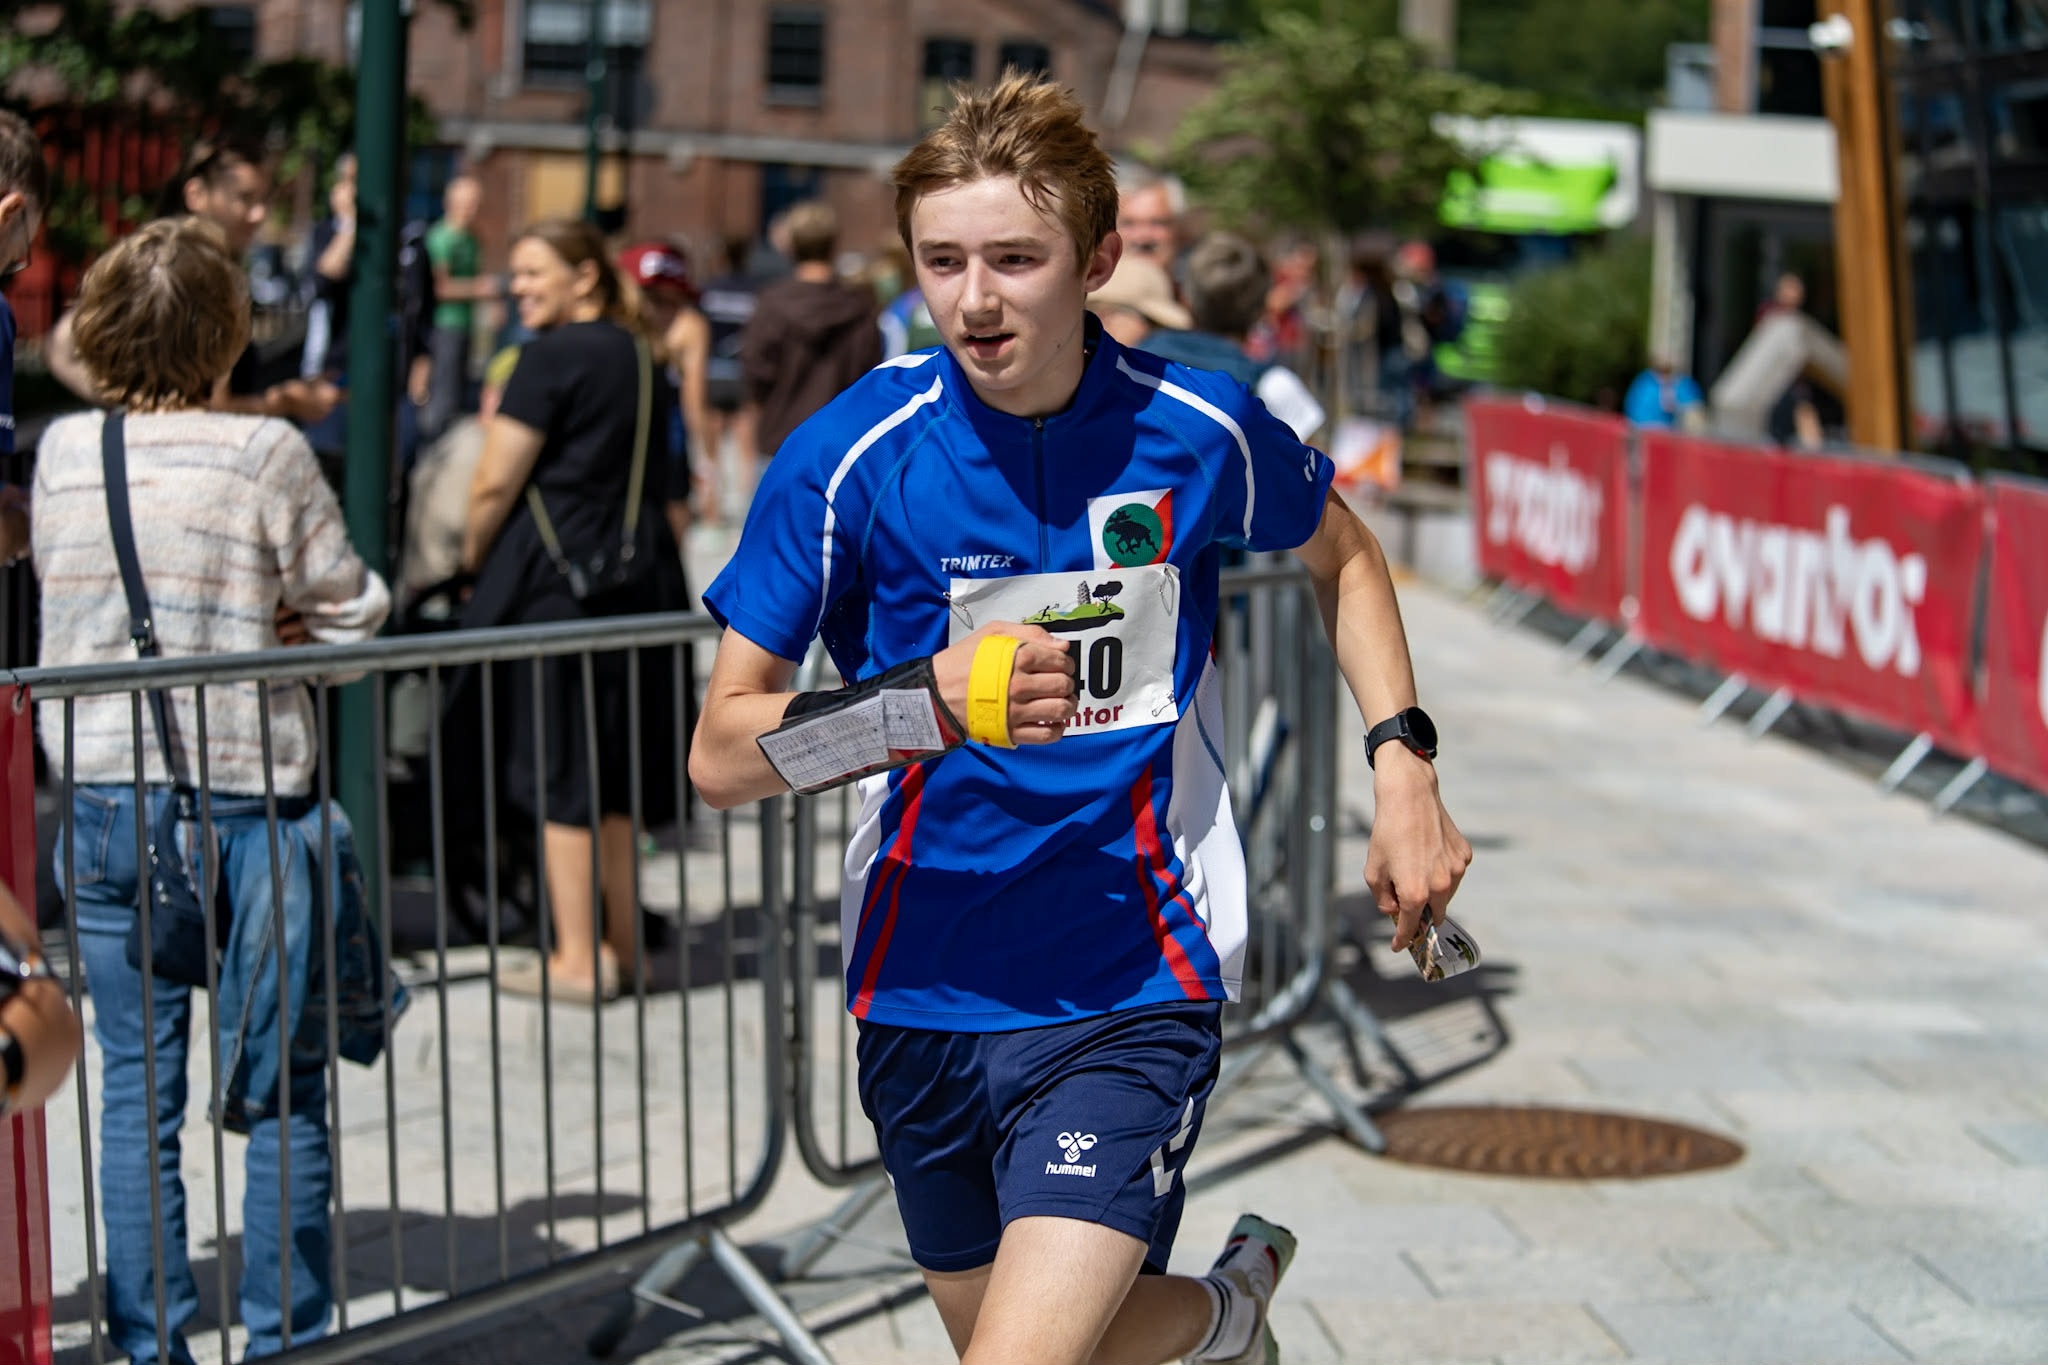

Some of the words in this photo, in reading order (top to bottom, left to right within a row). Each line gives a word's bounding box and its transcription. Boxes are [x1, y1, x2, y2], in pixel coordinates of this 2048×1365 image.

[940, 554, 1015, 573] TRIMTEX
[1063, 704, 1124, 728] ntor
[1045, 1161, 1097, 1178] hummel
